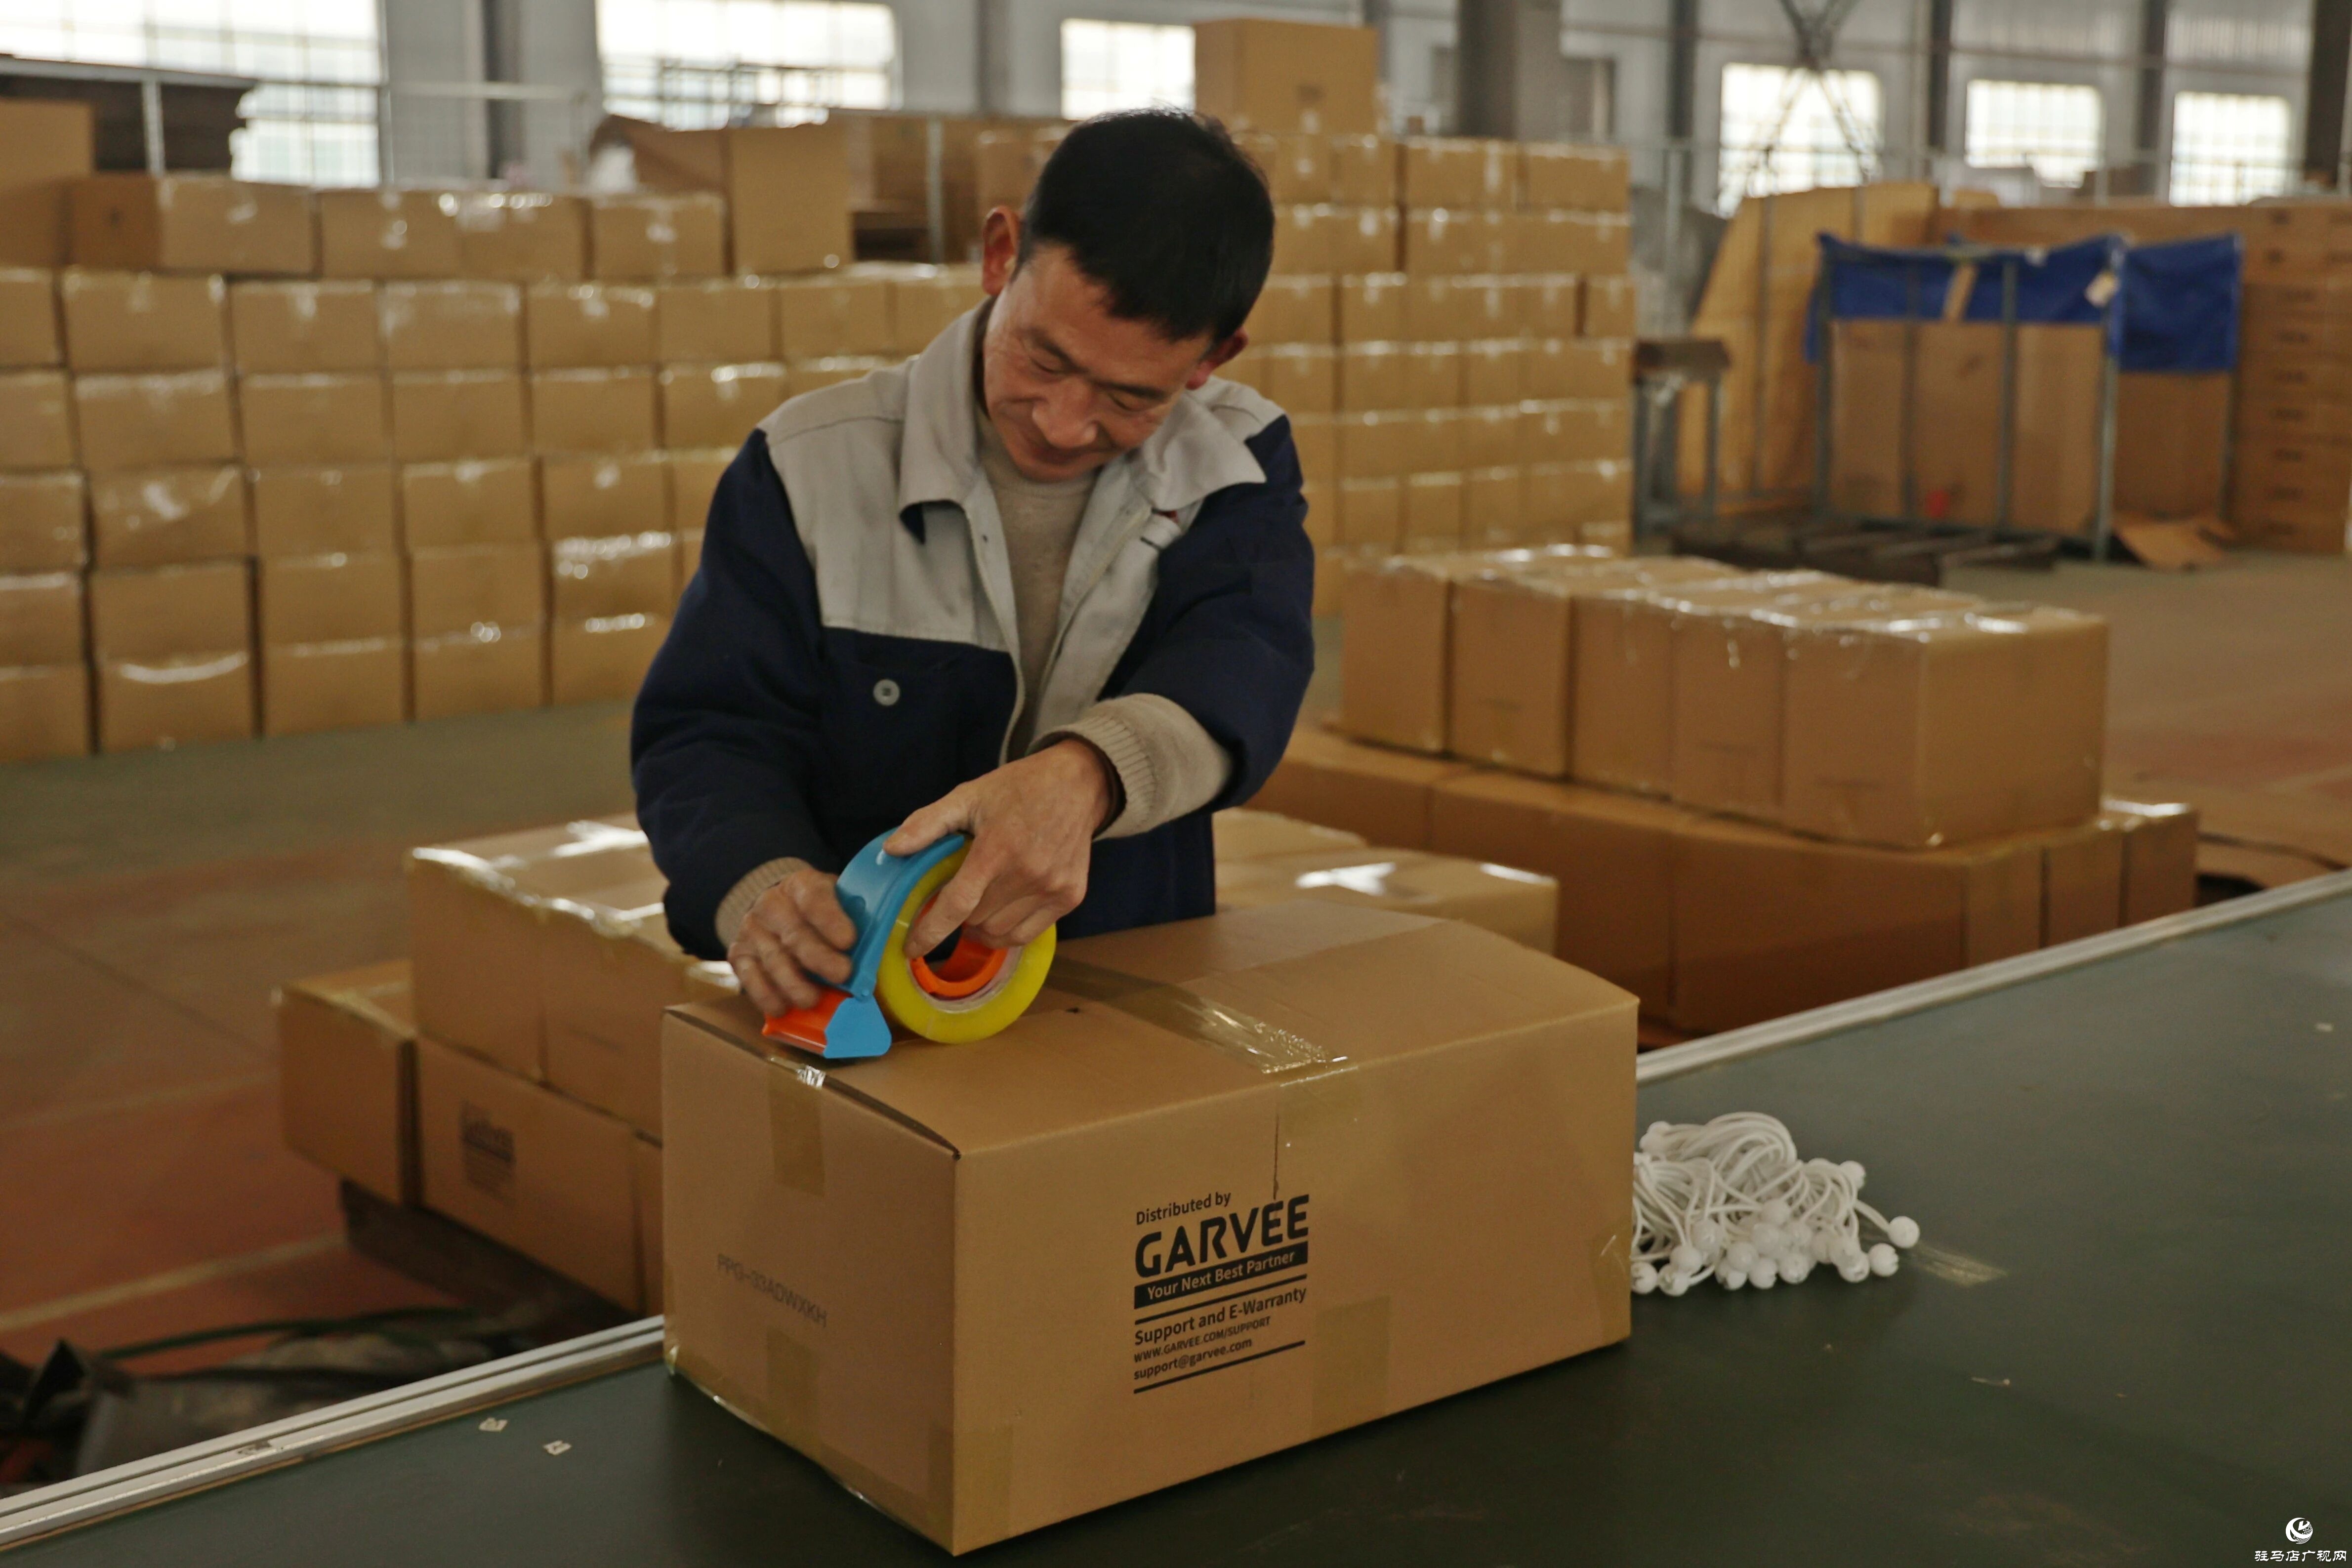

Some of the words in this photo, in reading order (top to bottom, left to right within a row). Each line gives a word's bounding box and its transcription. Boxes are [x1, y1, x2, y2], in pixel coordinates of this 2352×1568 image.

[1136, 1194, 1211, 1225] Distributed
[1215, 1192, 1232, 1208] by
[1135, 1194, 1310, 1279] GARVEE
[1148, 1281, 1179, 1301] Your
[1181, 1272, 1211, 1292] Next
[1215, 1264, 1243, 1283] Best
[1246, 1250, 1295, 1275] Partner
[1134, 1318, 1195, 1346] Support
[1198, 1307, 1225, 1328] and
[1229, 1287, 1307, 1320] E-Warranty
[1134, 1316, 1271, 1363] WWW.GARVEE.COM/SUPPORT
[1133, 1338, 1252, 1380] support@garvee.com
